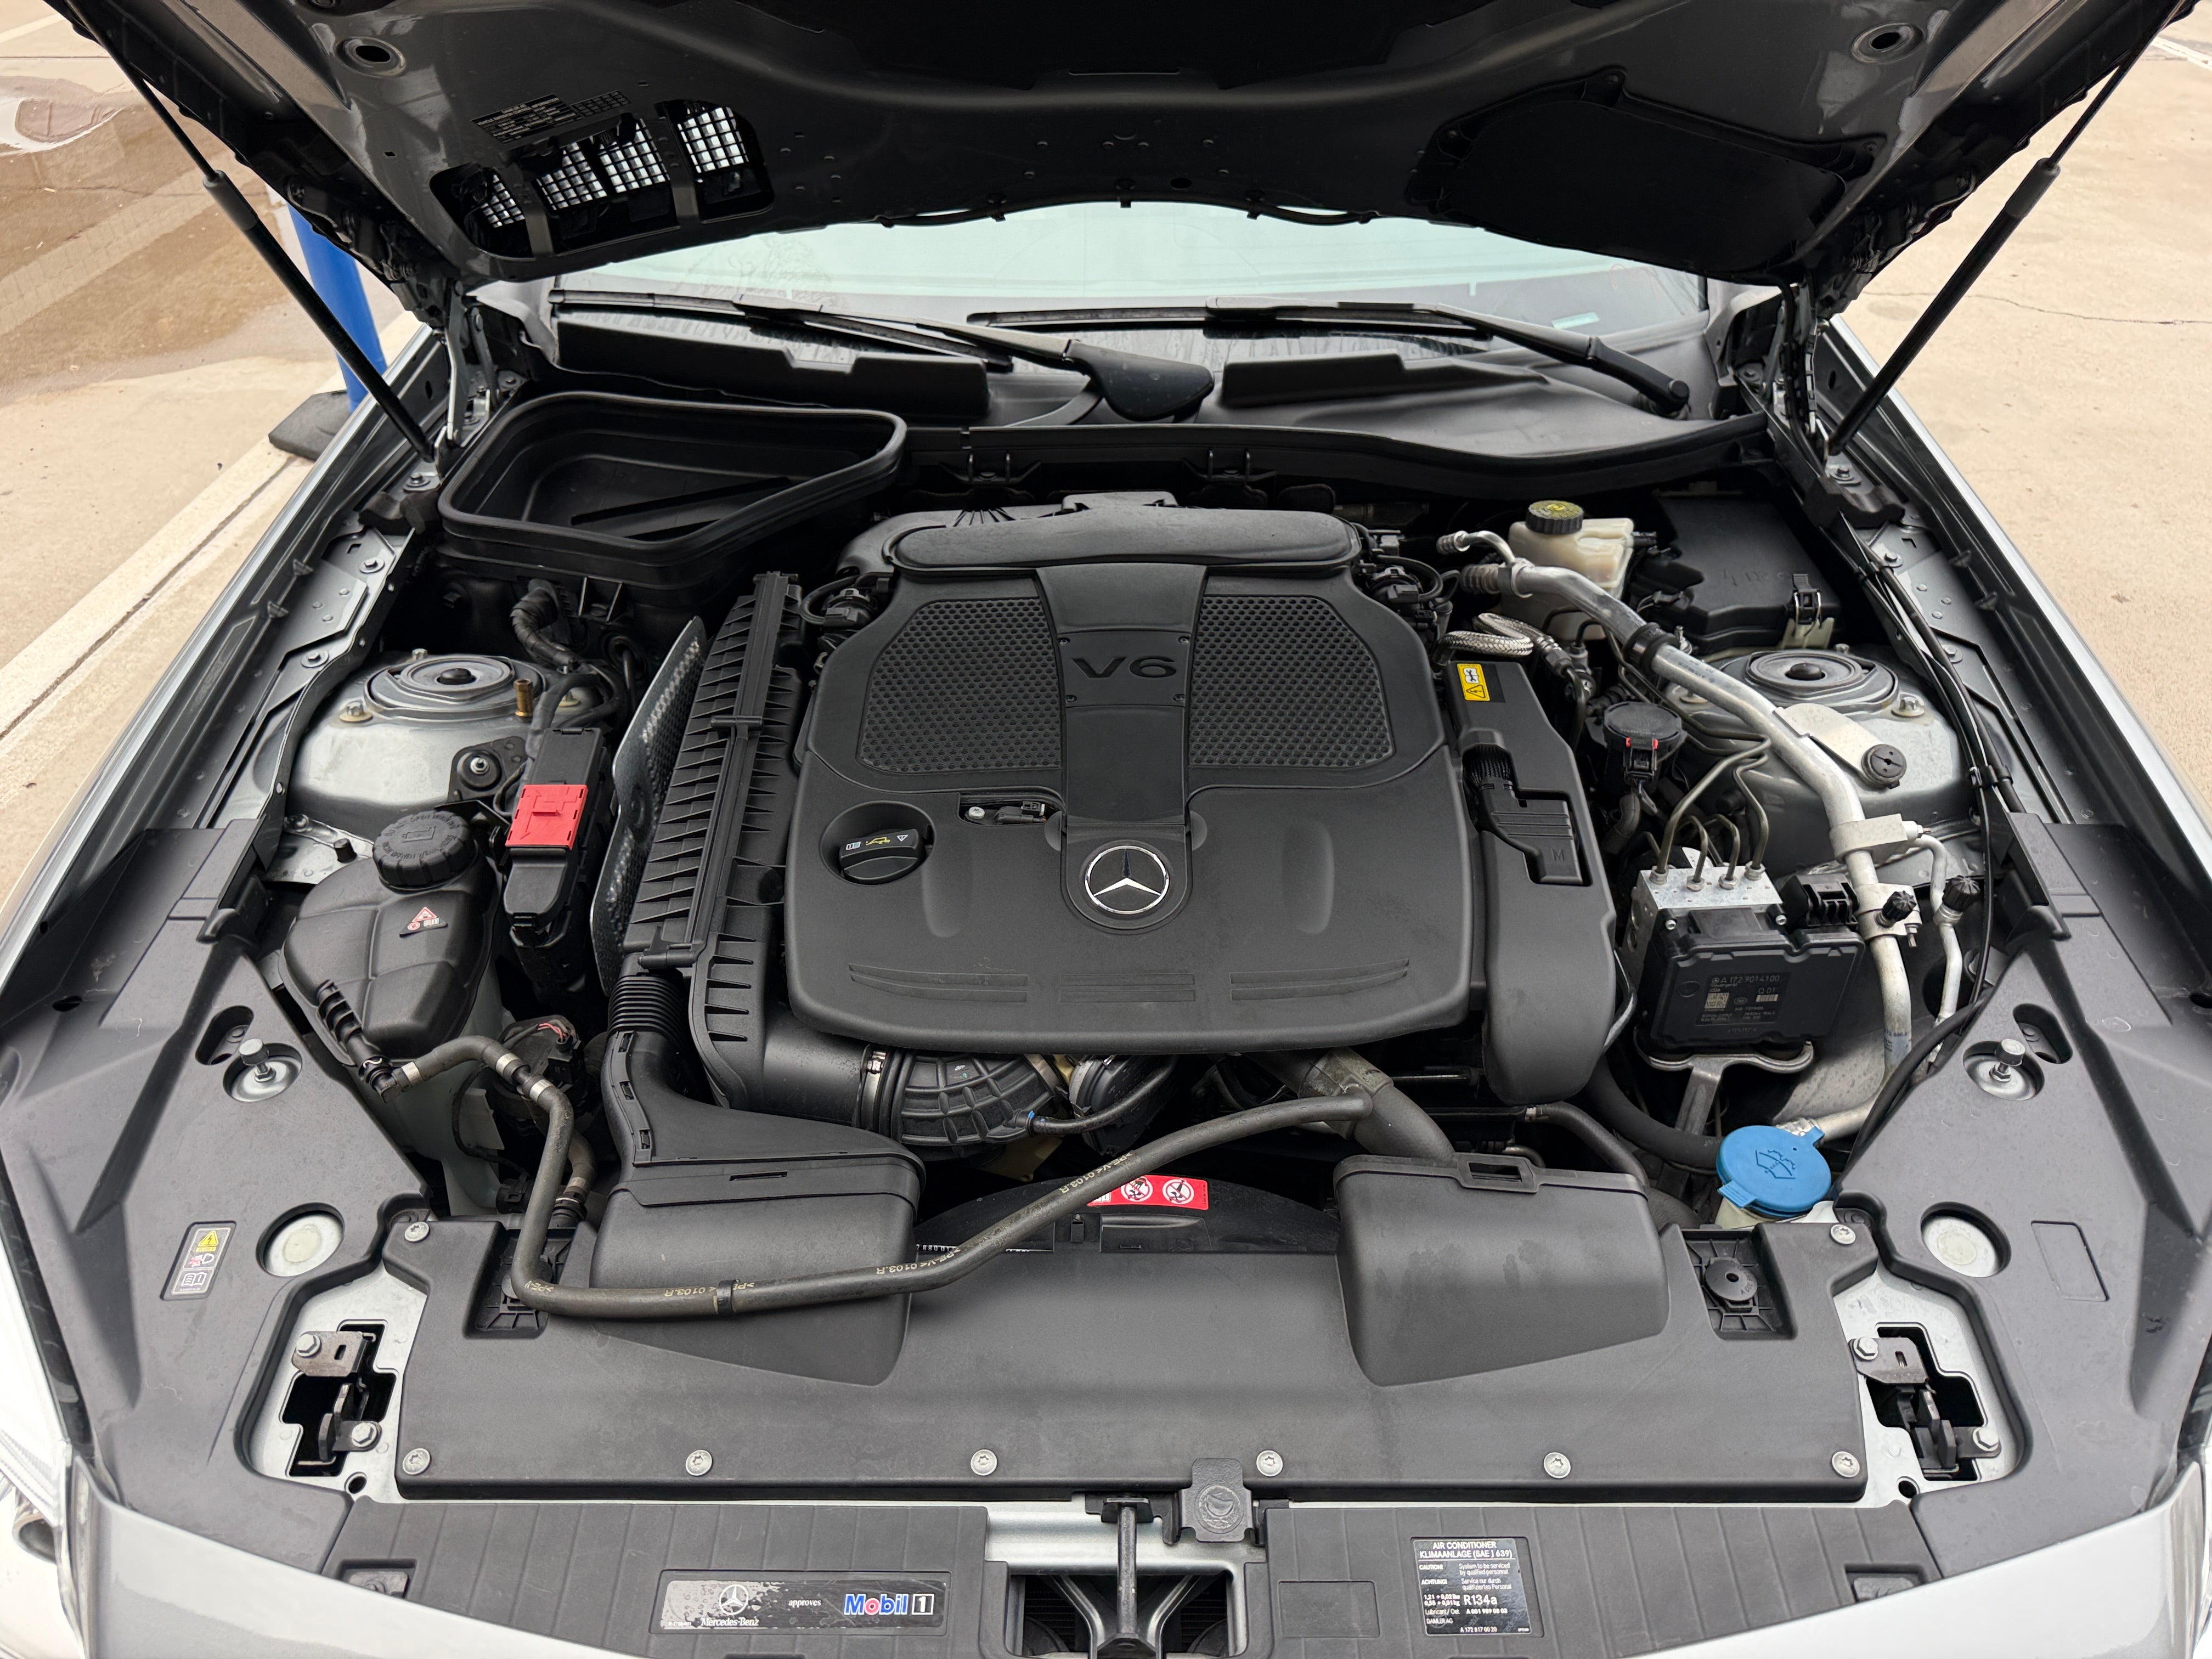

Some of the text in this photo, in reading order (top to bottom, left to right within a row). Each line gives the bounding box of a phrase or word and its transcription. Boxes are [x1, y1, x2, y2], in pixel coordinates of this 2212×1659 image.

[1072, 655, 1179, 679] V6
[1550, 848, 1565, 861] M
[1432, 1541, 1497, 1550] AIR CONDITIONER
[1419, 1550, 1472, 1559] KLIMAANLAGE
[1496, 1549, 1513, 1558] 639)
[1463, 1594, 1498, 1606] R134a
[700, 1616, 759, 1627] Mercedes-Benz
[788, 1598, 822, 1607] approves
[843, 1593, 910, 1616] Mobil
